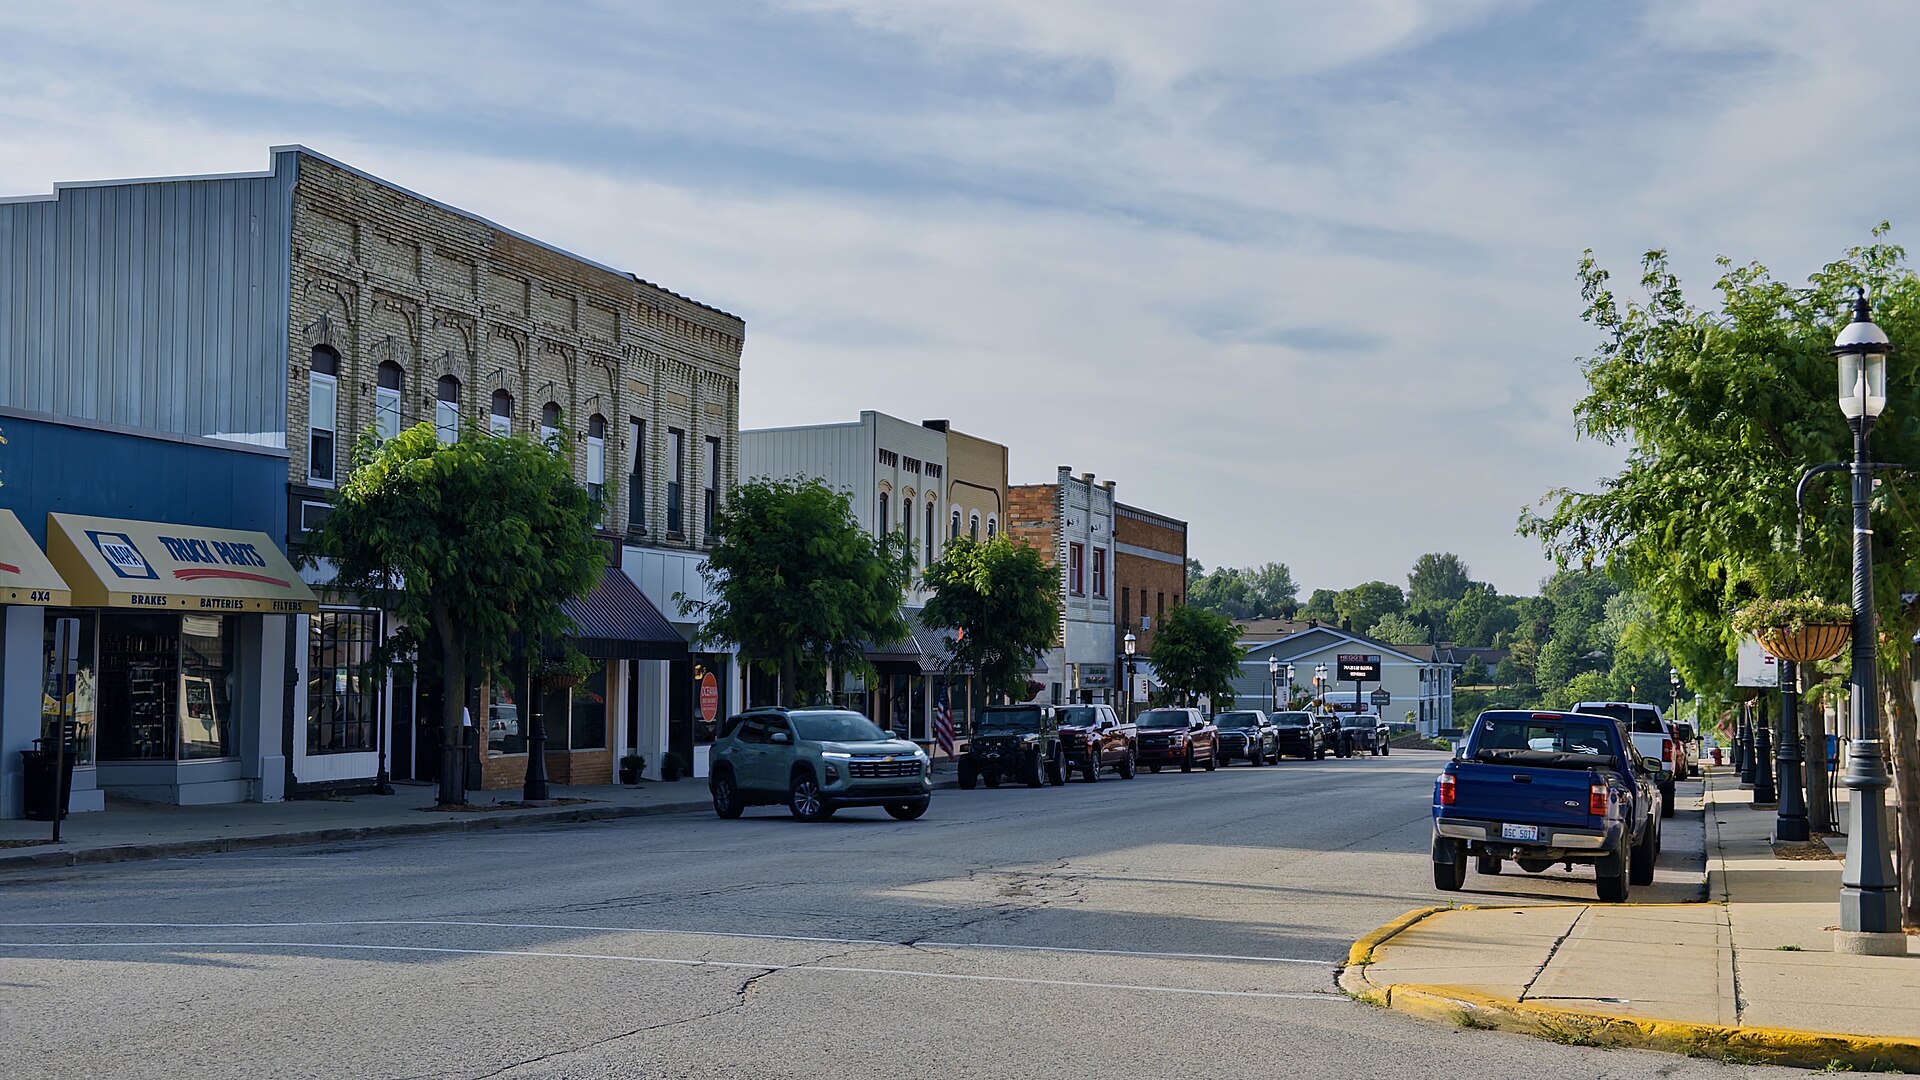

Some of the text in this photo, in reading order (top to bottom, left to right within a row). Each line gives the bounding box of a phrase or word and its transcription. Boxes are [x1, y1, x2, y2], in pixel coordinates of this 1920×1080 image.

[105, 544, 142, 566] NAPA
[157, 536, 266, 568] TRUCK PARTS
[31, 591, 50, 601] 4X4
[131, 594, 302, 611] BRAKES BATTERIES FILTERS
[1520, 830, 1535, 839] 5017
